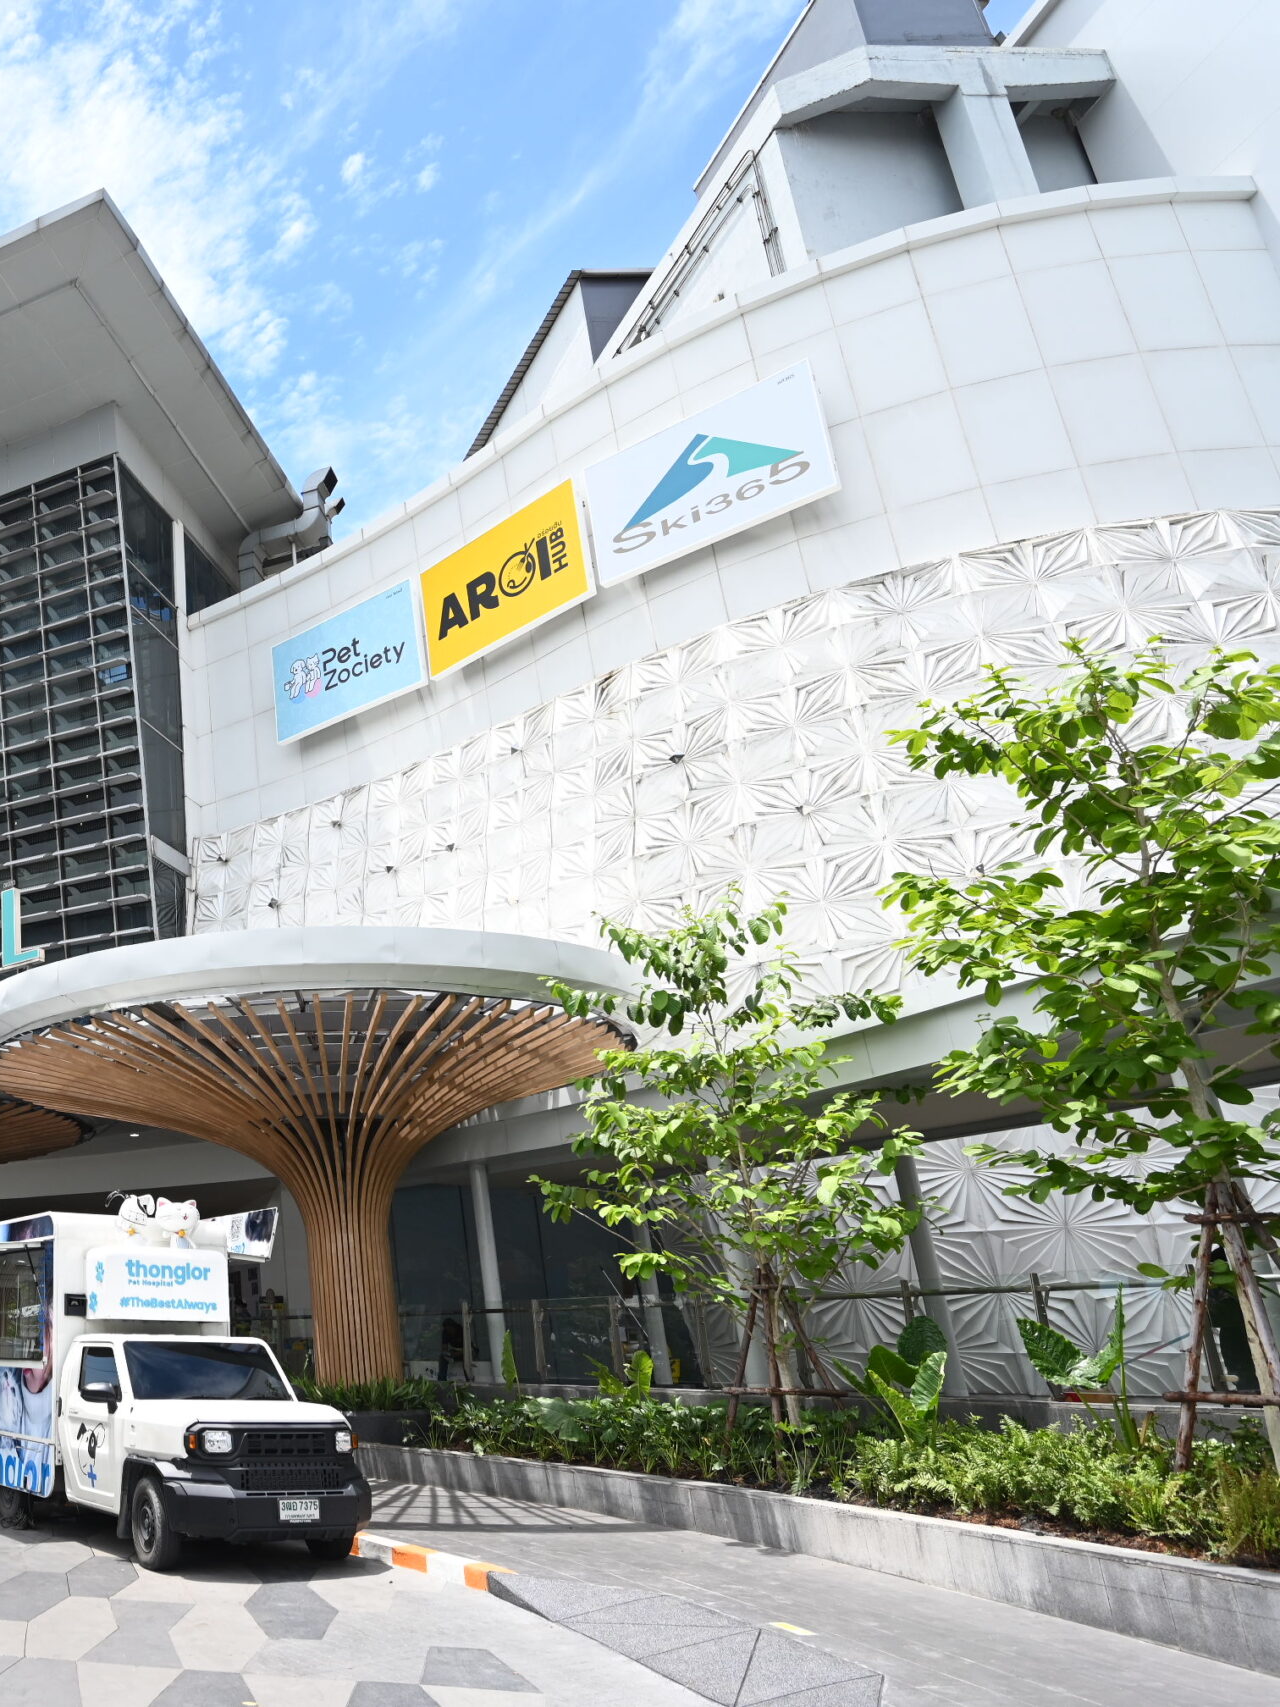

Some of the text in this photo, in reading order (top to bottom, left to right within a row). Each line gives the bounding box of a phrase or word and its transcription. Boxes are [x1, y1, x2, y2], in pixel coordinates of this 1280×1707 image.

[612, 450, 811, 555] Ski365
[549, 527, 569, 573] HUB
[438, 536, 552, 641] AROI
[321, 637, 361, 672] Pet
[323, 641, 406, 692] Zociety
[125, 1259, 211, 1286] thonglor
[142, 1279, 174, 1288] Hospital
[119, 1296, 218, 1314] #TheBestAlways
[299, 1500, 319, 1511] 7375
